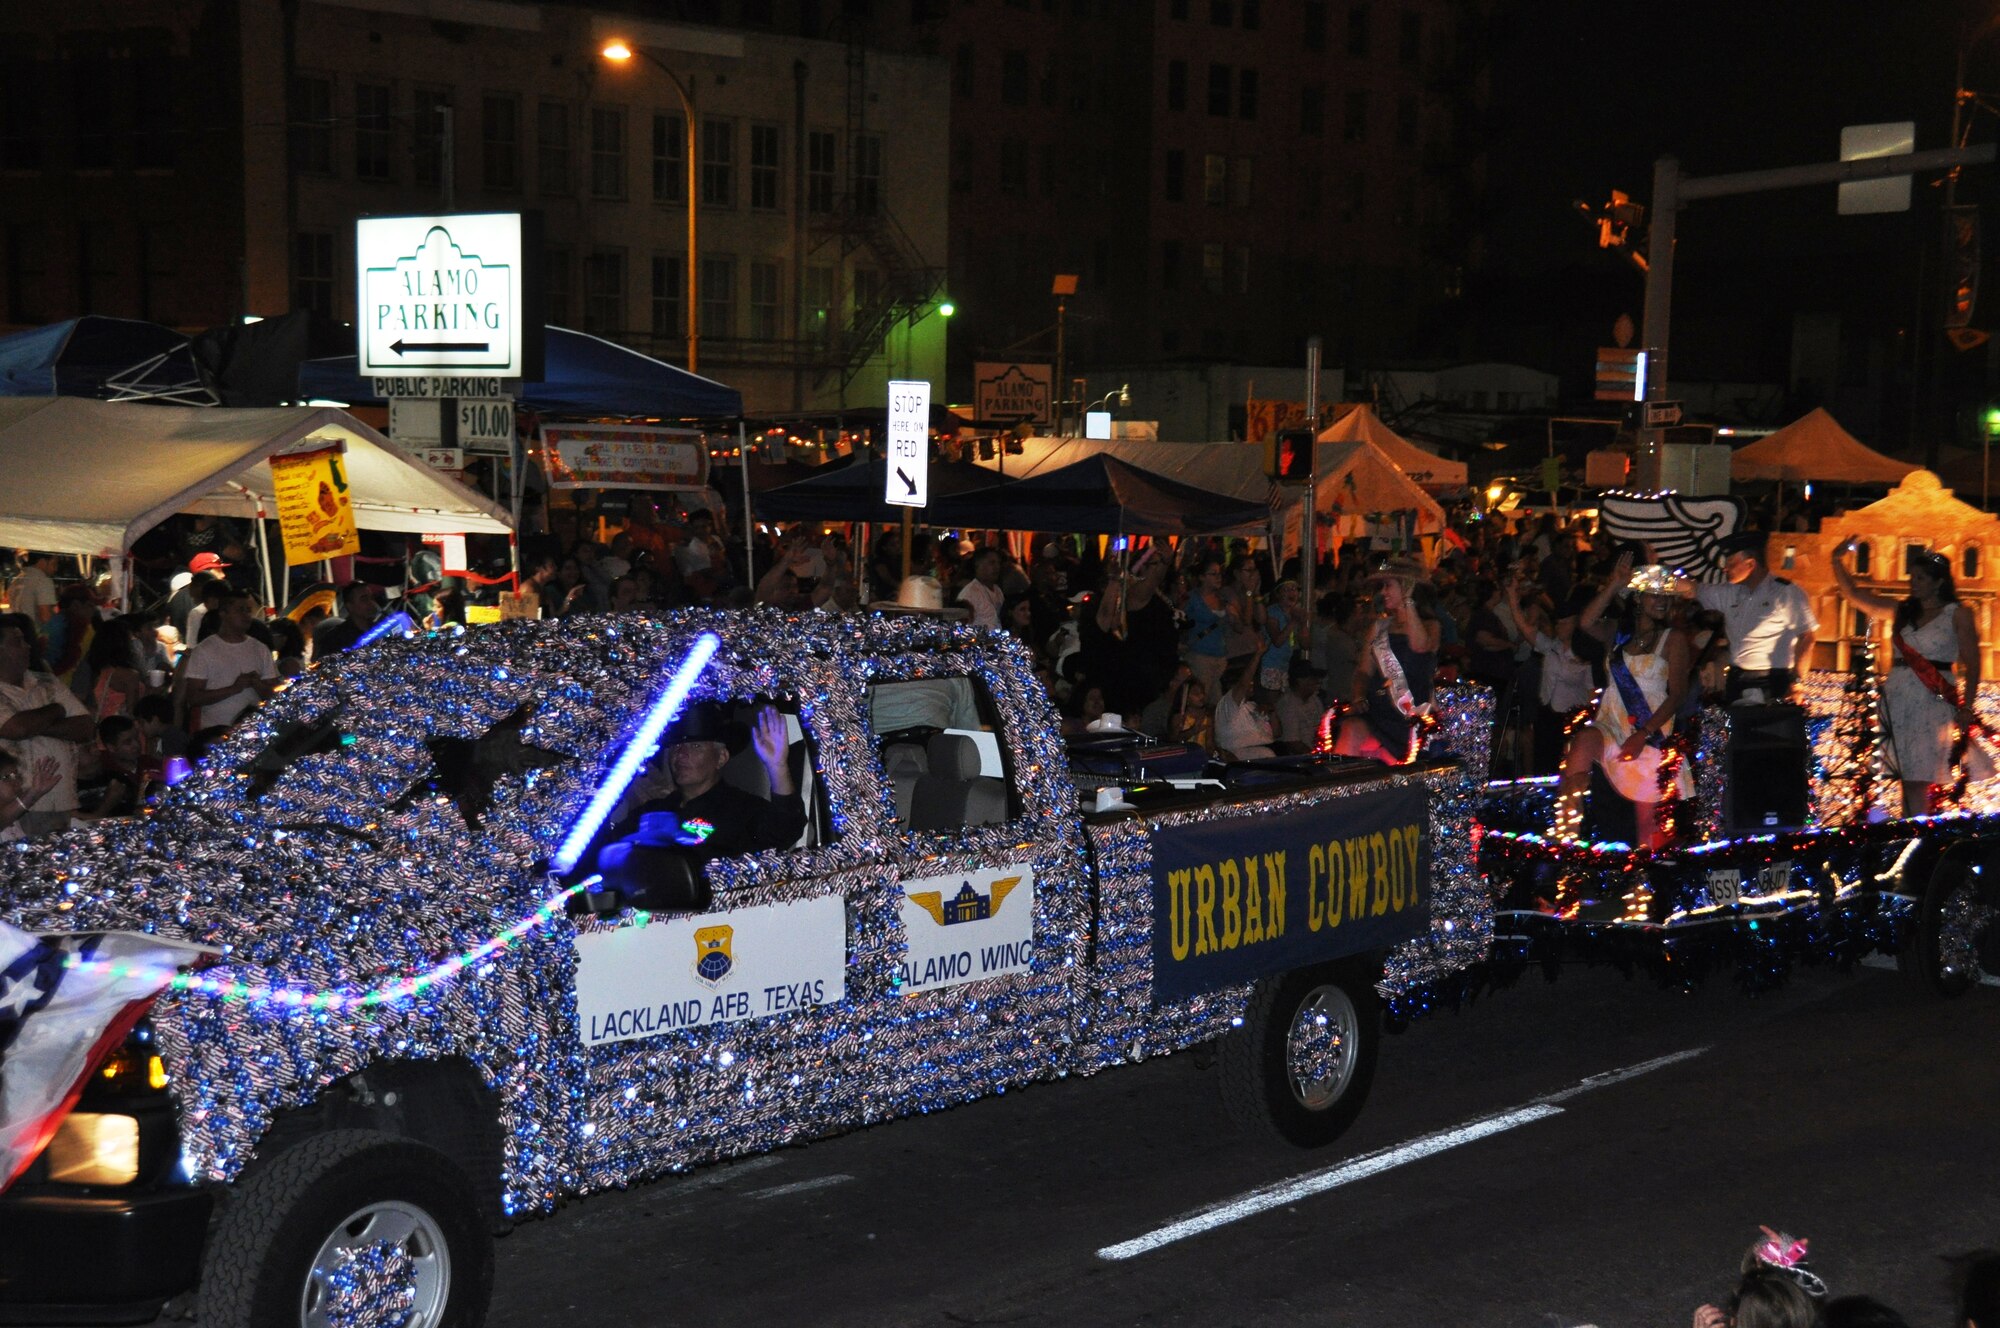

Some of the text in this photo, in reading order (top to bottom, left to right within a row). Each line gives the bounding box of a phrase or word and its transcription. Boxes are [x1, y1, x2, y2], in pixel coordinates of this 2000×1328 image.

[400, 268, 478, 297] ALAMO
[378, 302, 500, 331] PARKING
[375, 377, 499, 397] PUBLIC PARKING
[996, 381, 1034, 397] ALAMO
[894, 395, 923, 413] STOP
[985, 398, 1043, 411] PARKING
[462, 404, 509, 438] $10.00
[893, 420, 924, 433] HERE ON
[896, 440, 918, 458] RED
[1168, 822, 1421, 962] URBAN COWBOY
[900, 940, 1031, 987] ALAMO WING
[591, 978, 824, 1041] LACKLAND AFB, TEXAS
